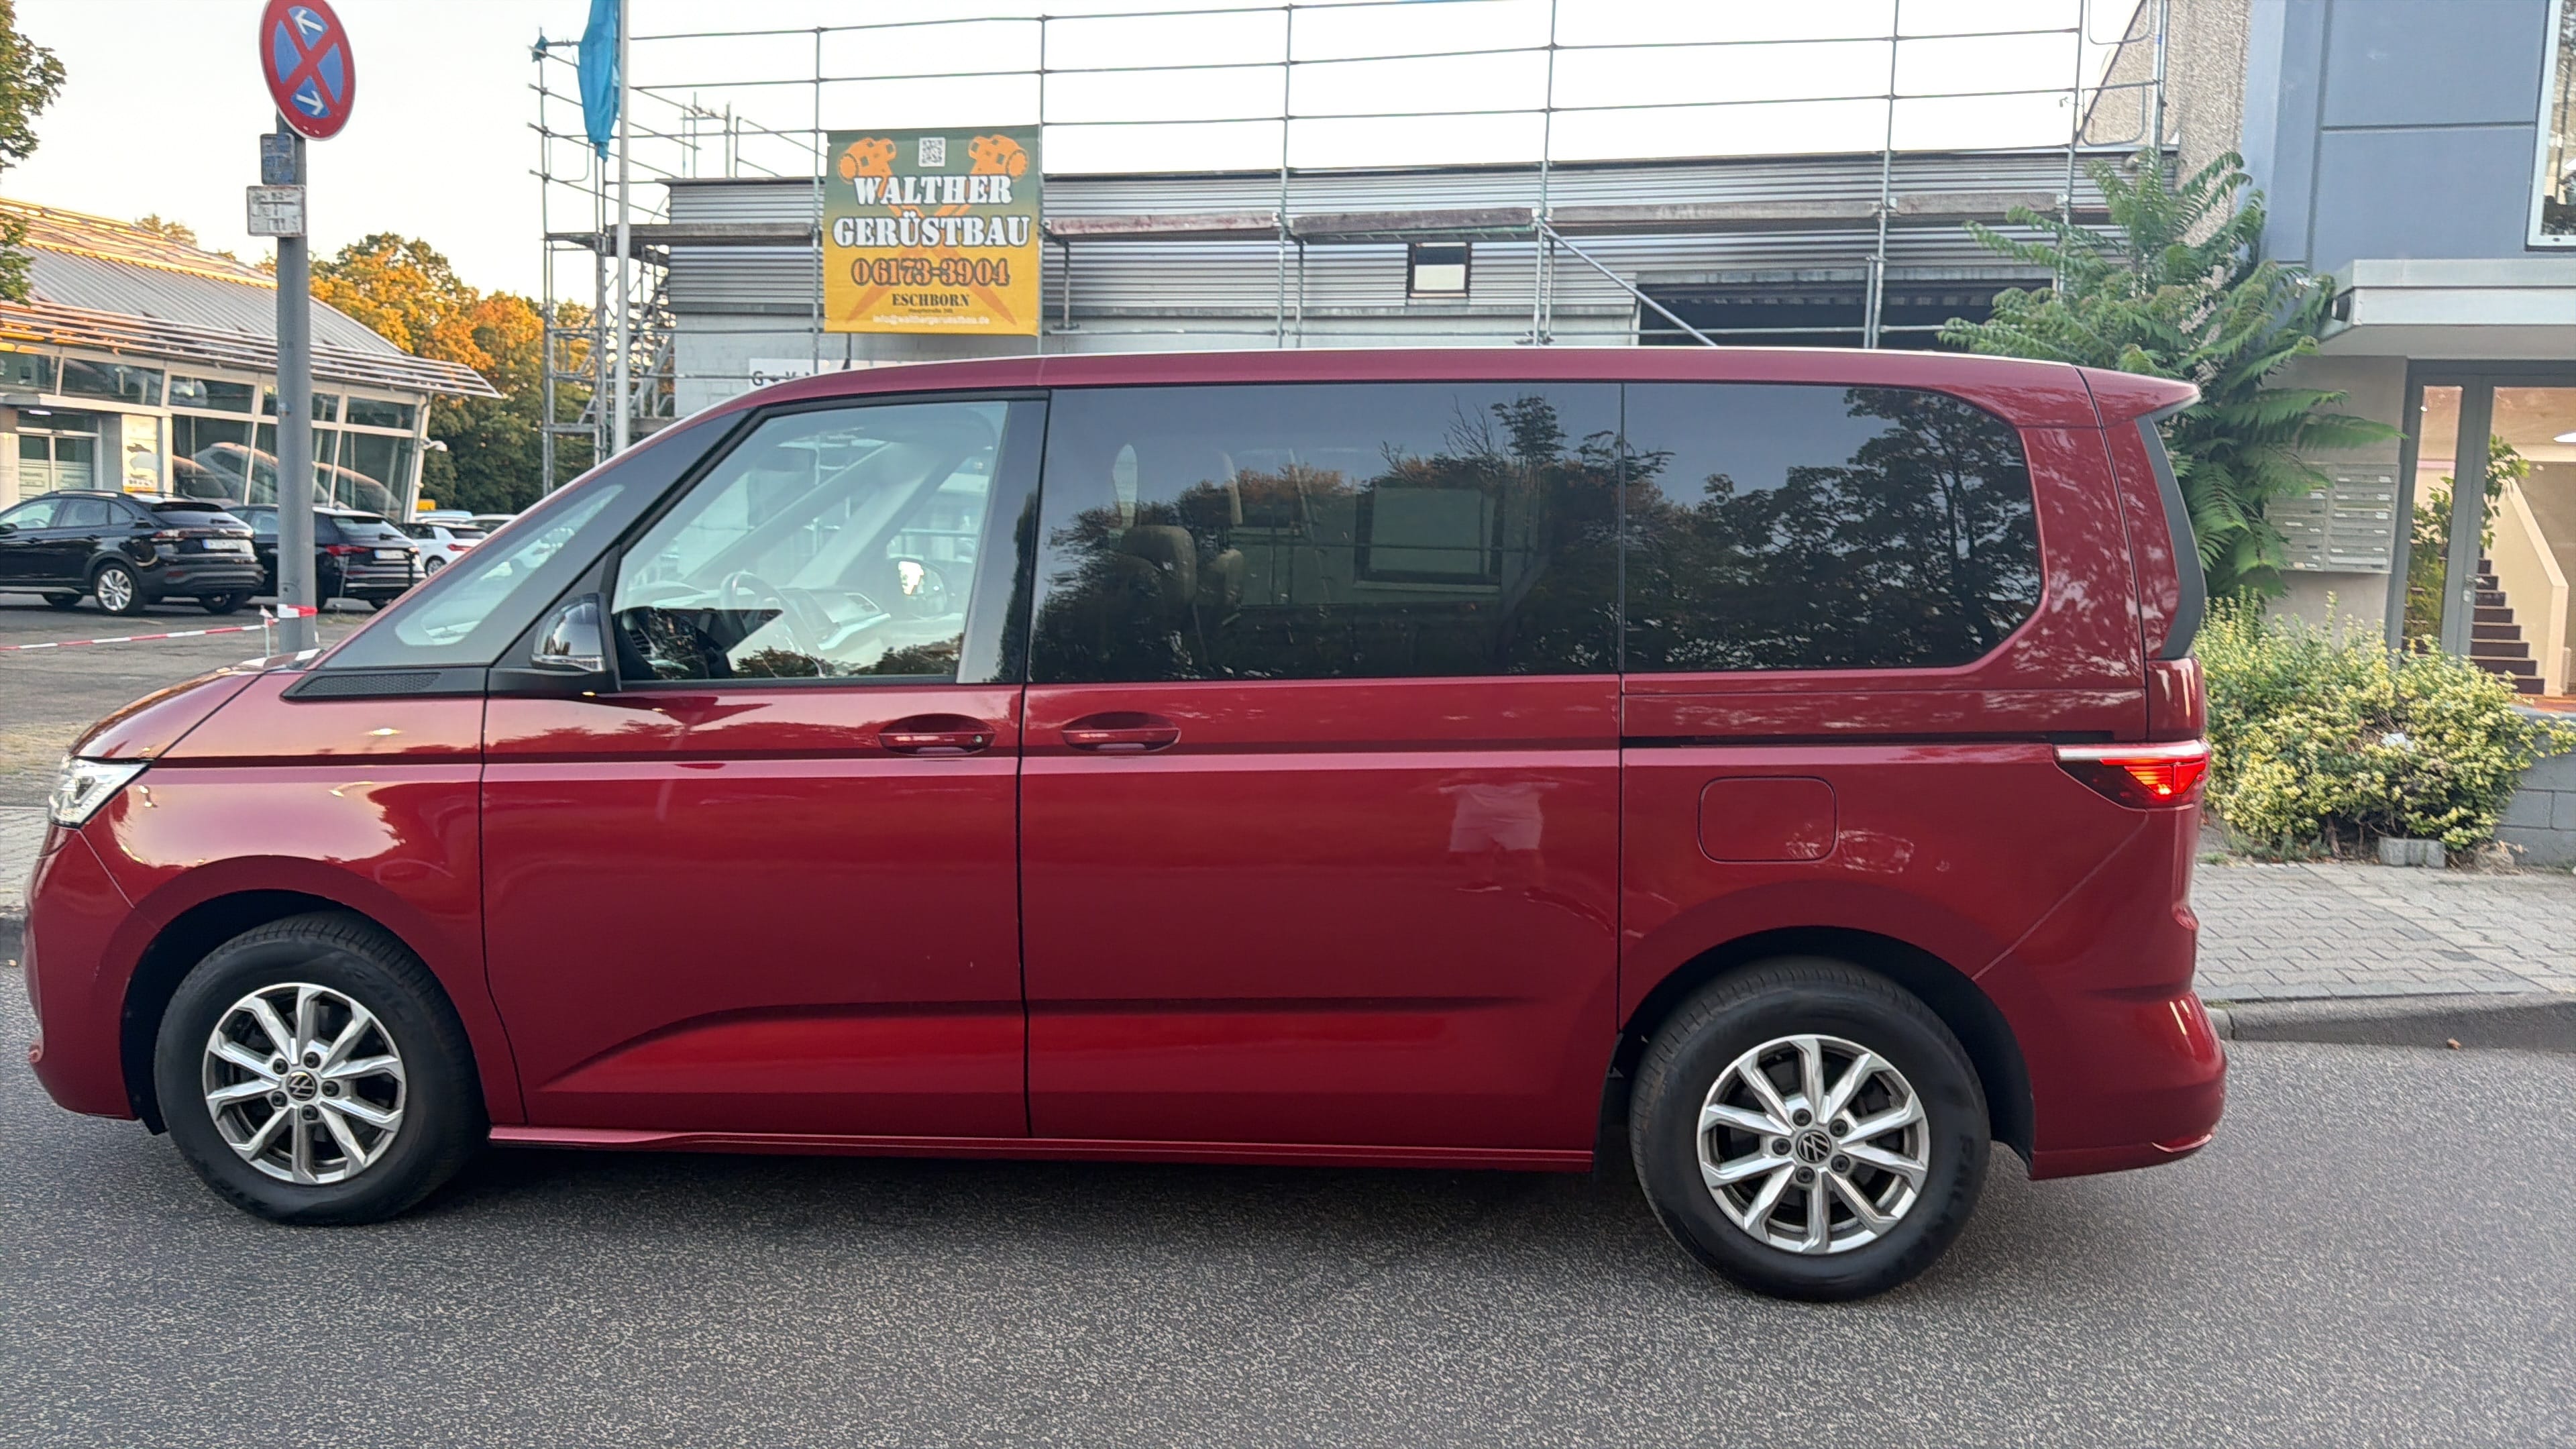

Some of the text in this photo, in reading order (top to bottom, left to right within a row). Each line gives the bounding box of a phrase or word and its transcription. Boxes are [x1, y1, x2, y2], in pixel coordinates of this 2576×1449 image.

[853, 175, 1013, 205] WALTHER
[833, 210, 1030, 246] GERÜSTBAU
[892, 293, 970, 307] ESCHBORN
